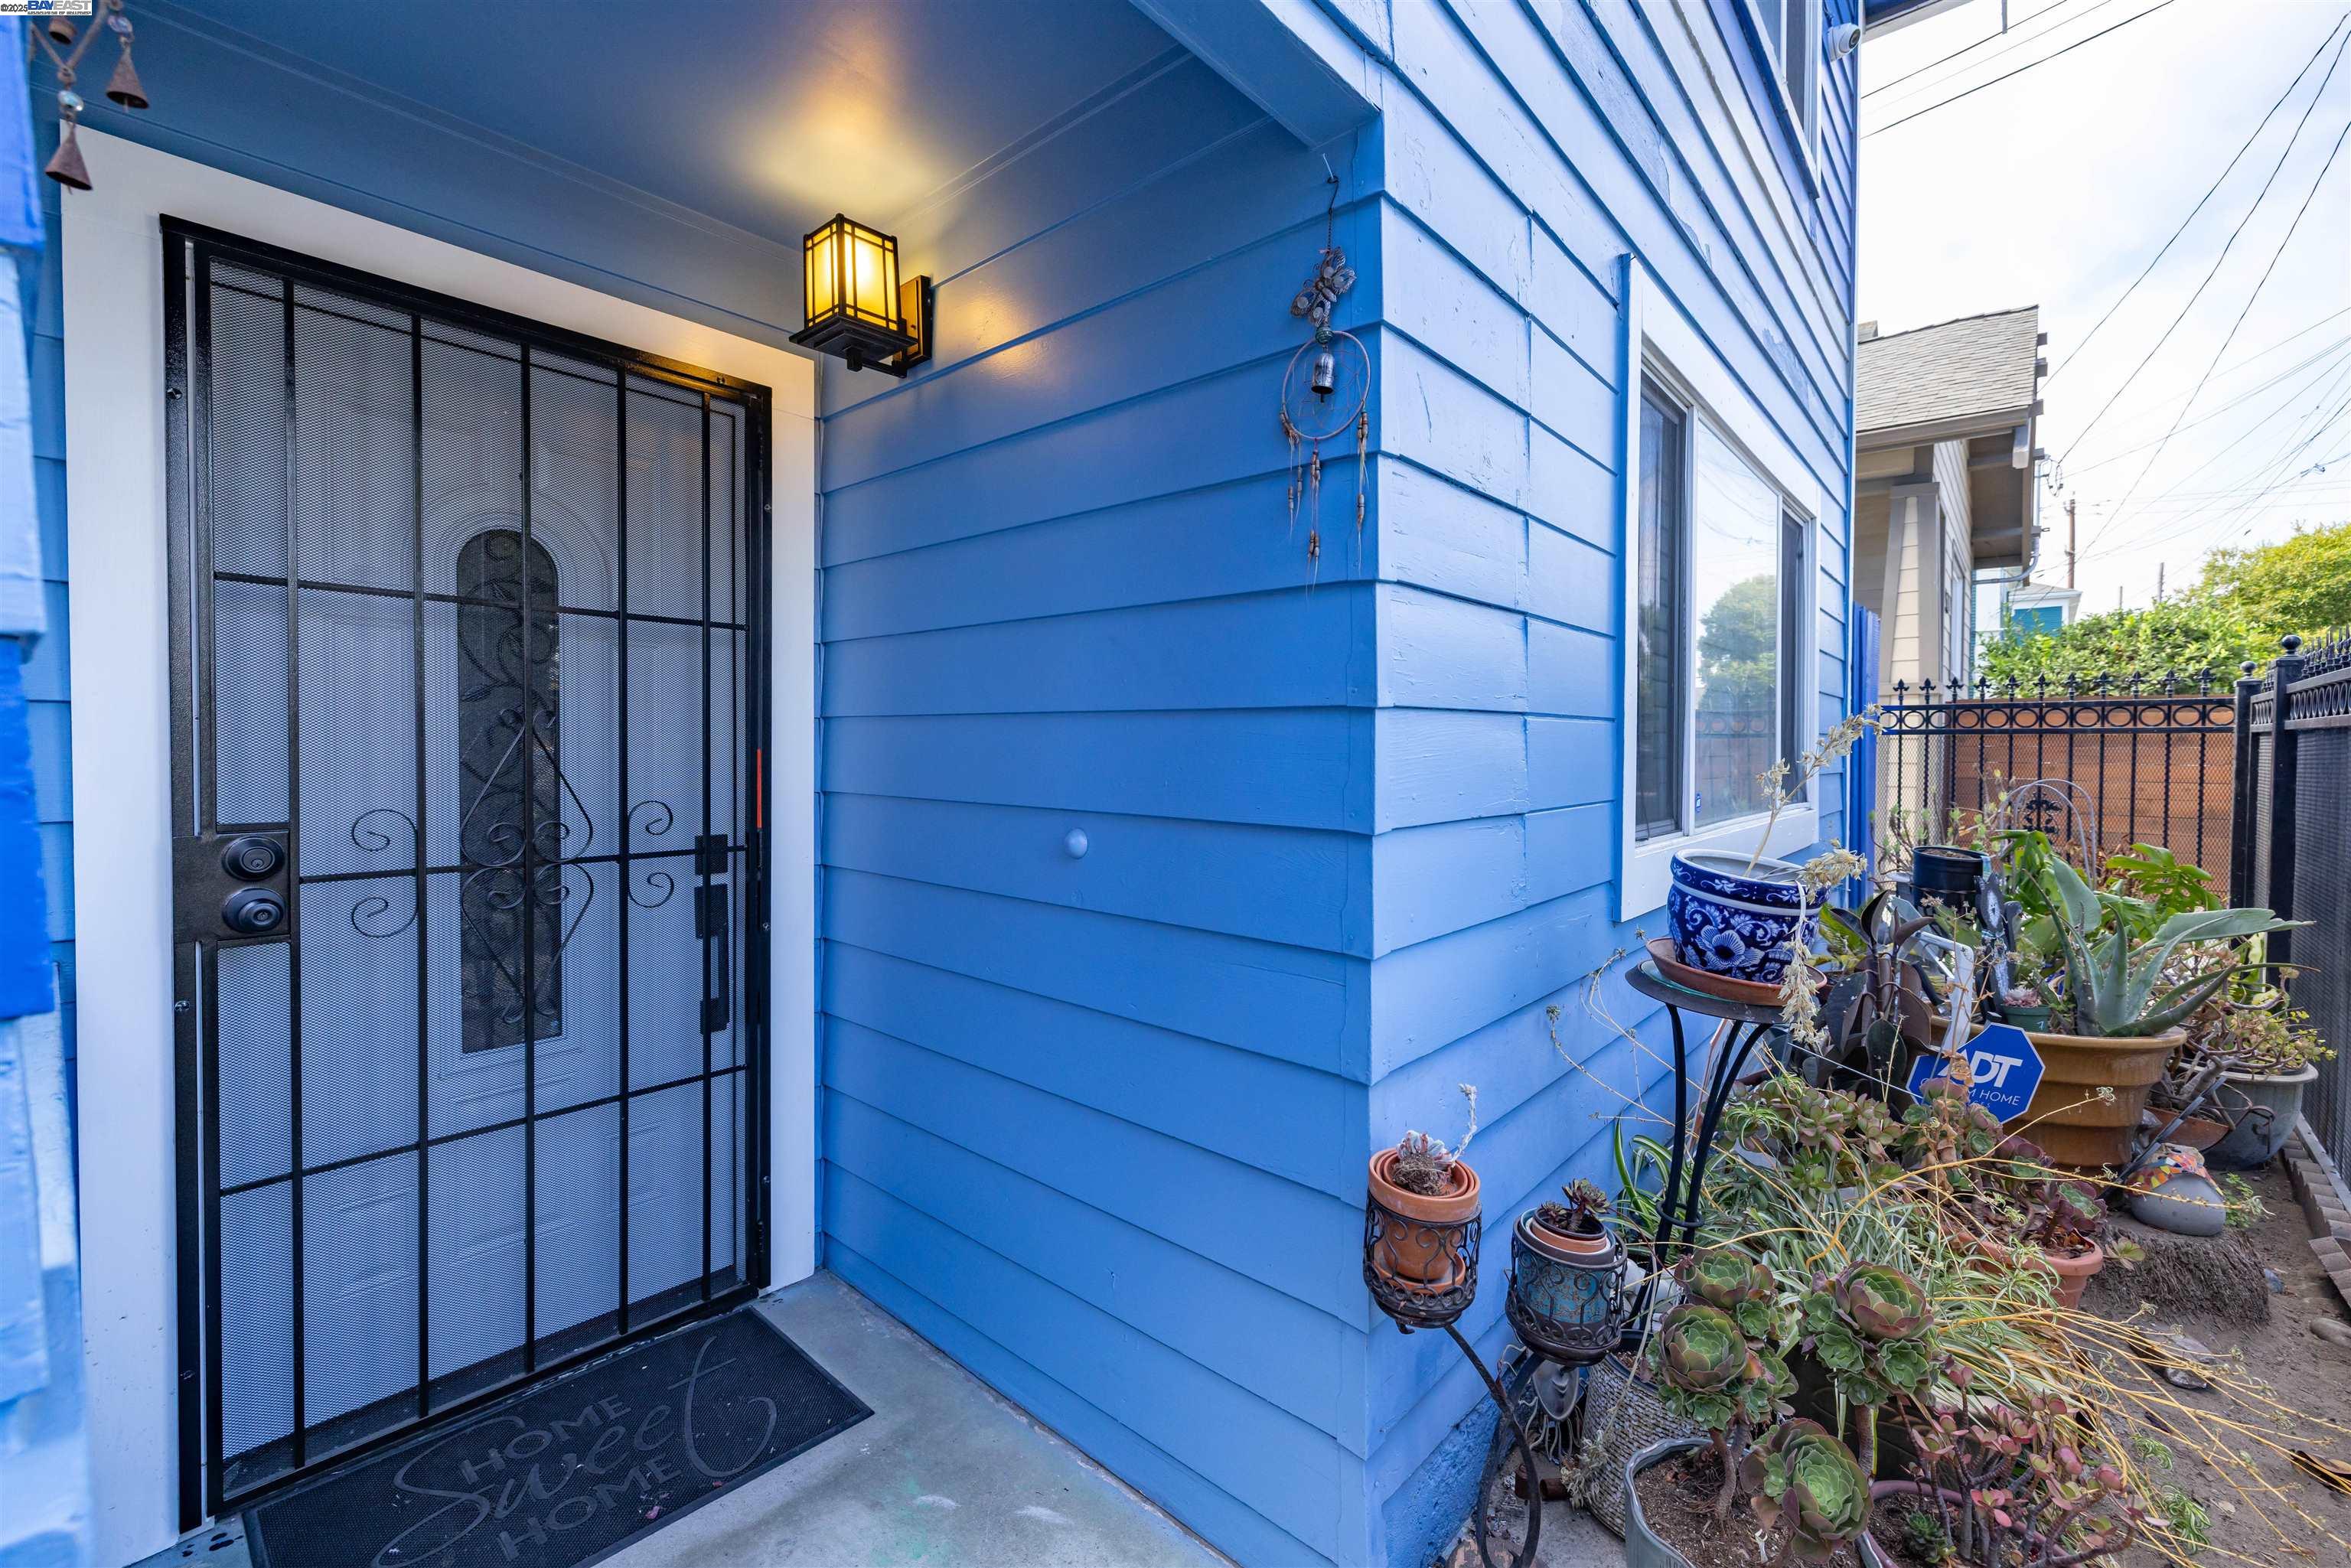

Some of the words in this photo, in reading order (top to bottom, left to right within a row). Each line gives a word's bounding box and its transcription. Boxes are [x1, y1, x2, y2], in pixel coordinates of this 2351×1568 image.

[1979, 1088, 2020, 1106] HOME
[370, 1336, 777, 1567] Sweet
[460, 1394, 631, 1485] HOME
[498, 1456, 683, 1561] HOME
